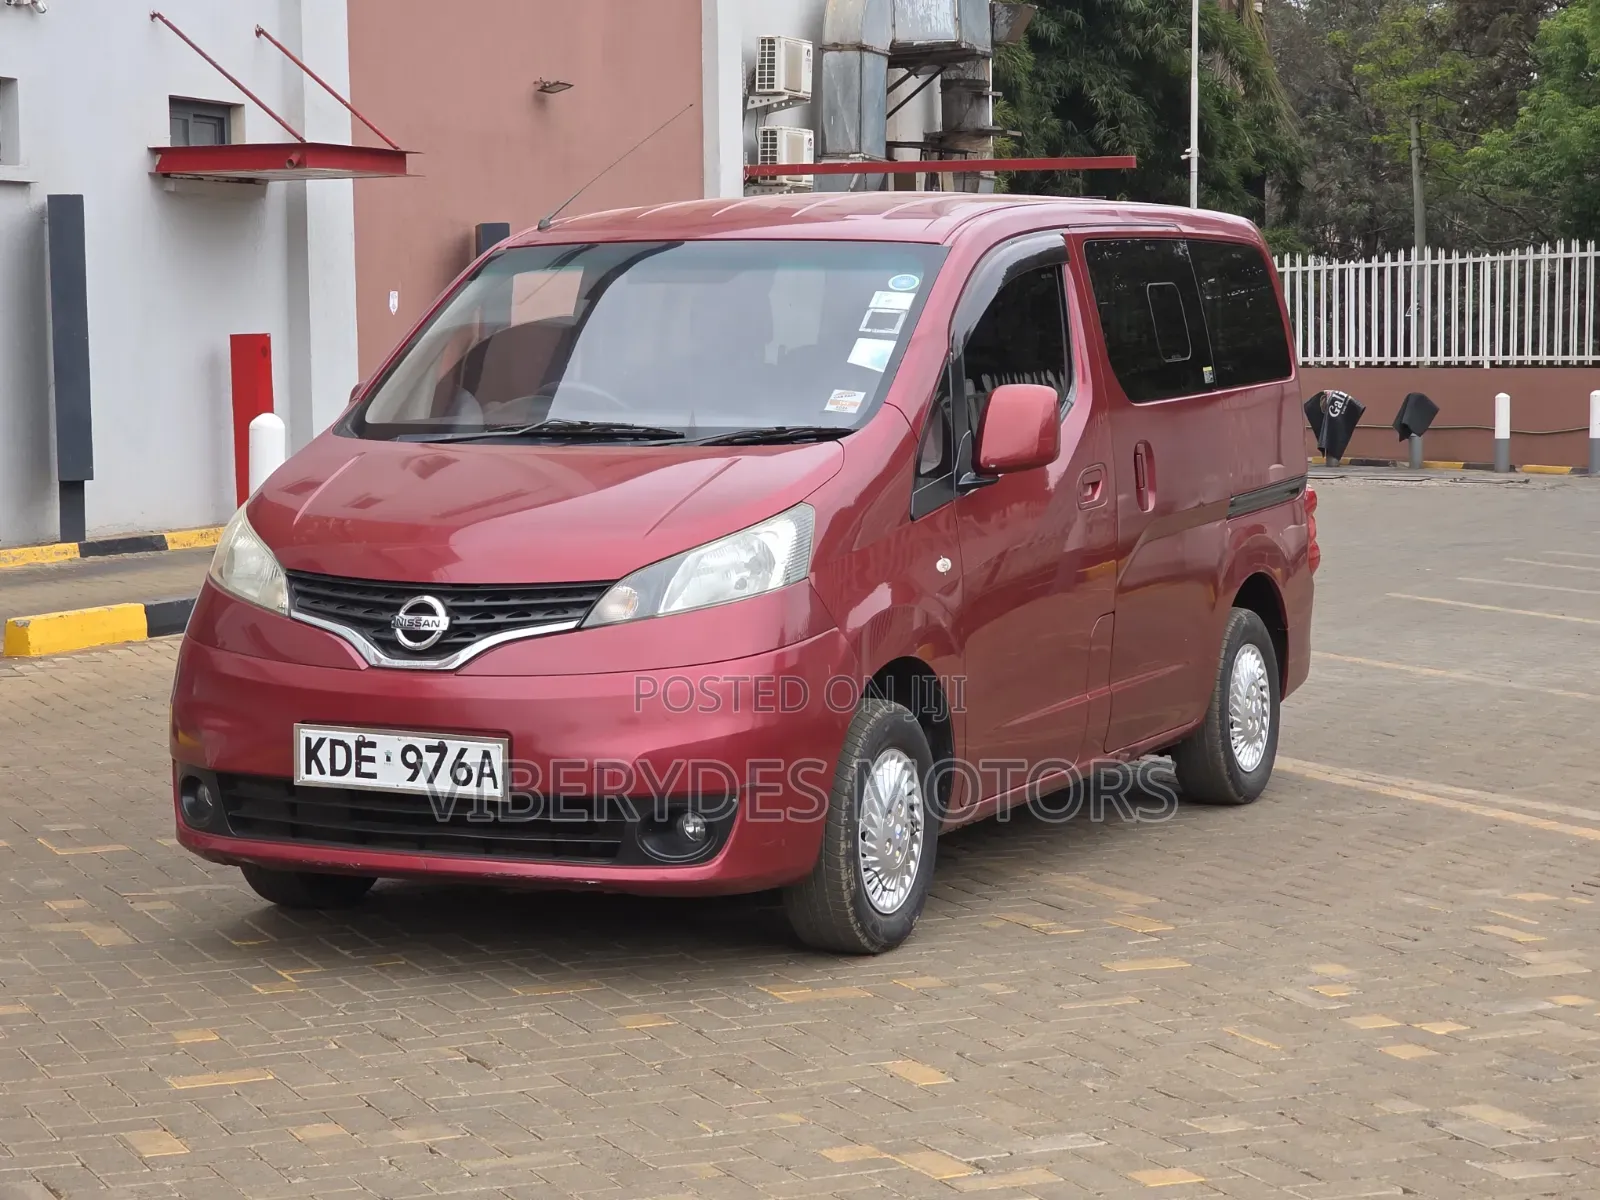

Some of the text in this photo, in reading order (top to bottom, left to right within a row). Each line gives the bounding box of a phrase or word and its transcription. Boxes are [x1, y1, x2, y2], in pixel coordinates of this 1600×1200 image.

[395, 617, 440, 628] NISSAN
[305, 737, 498, 789] KDE 976A
